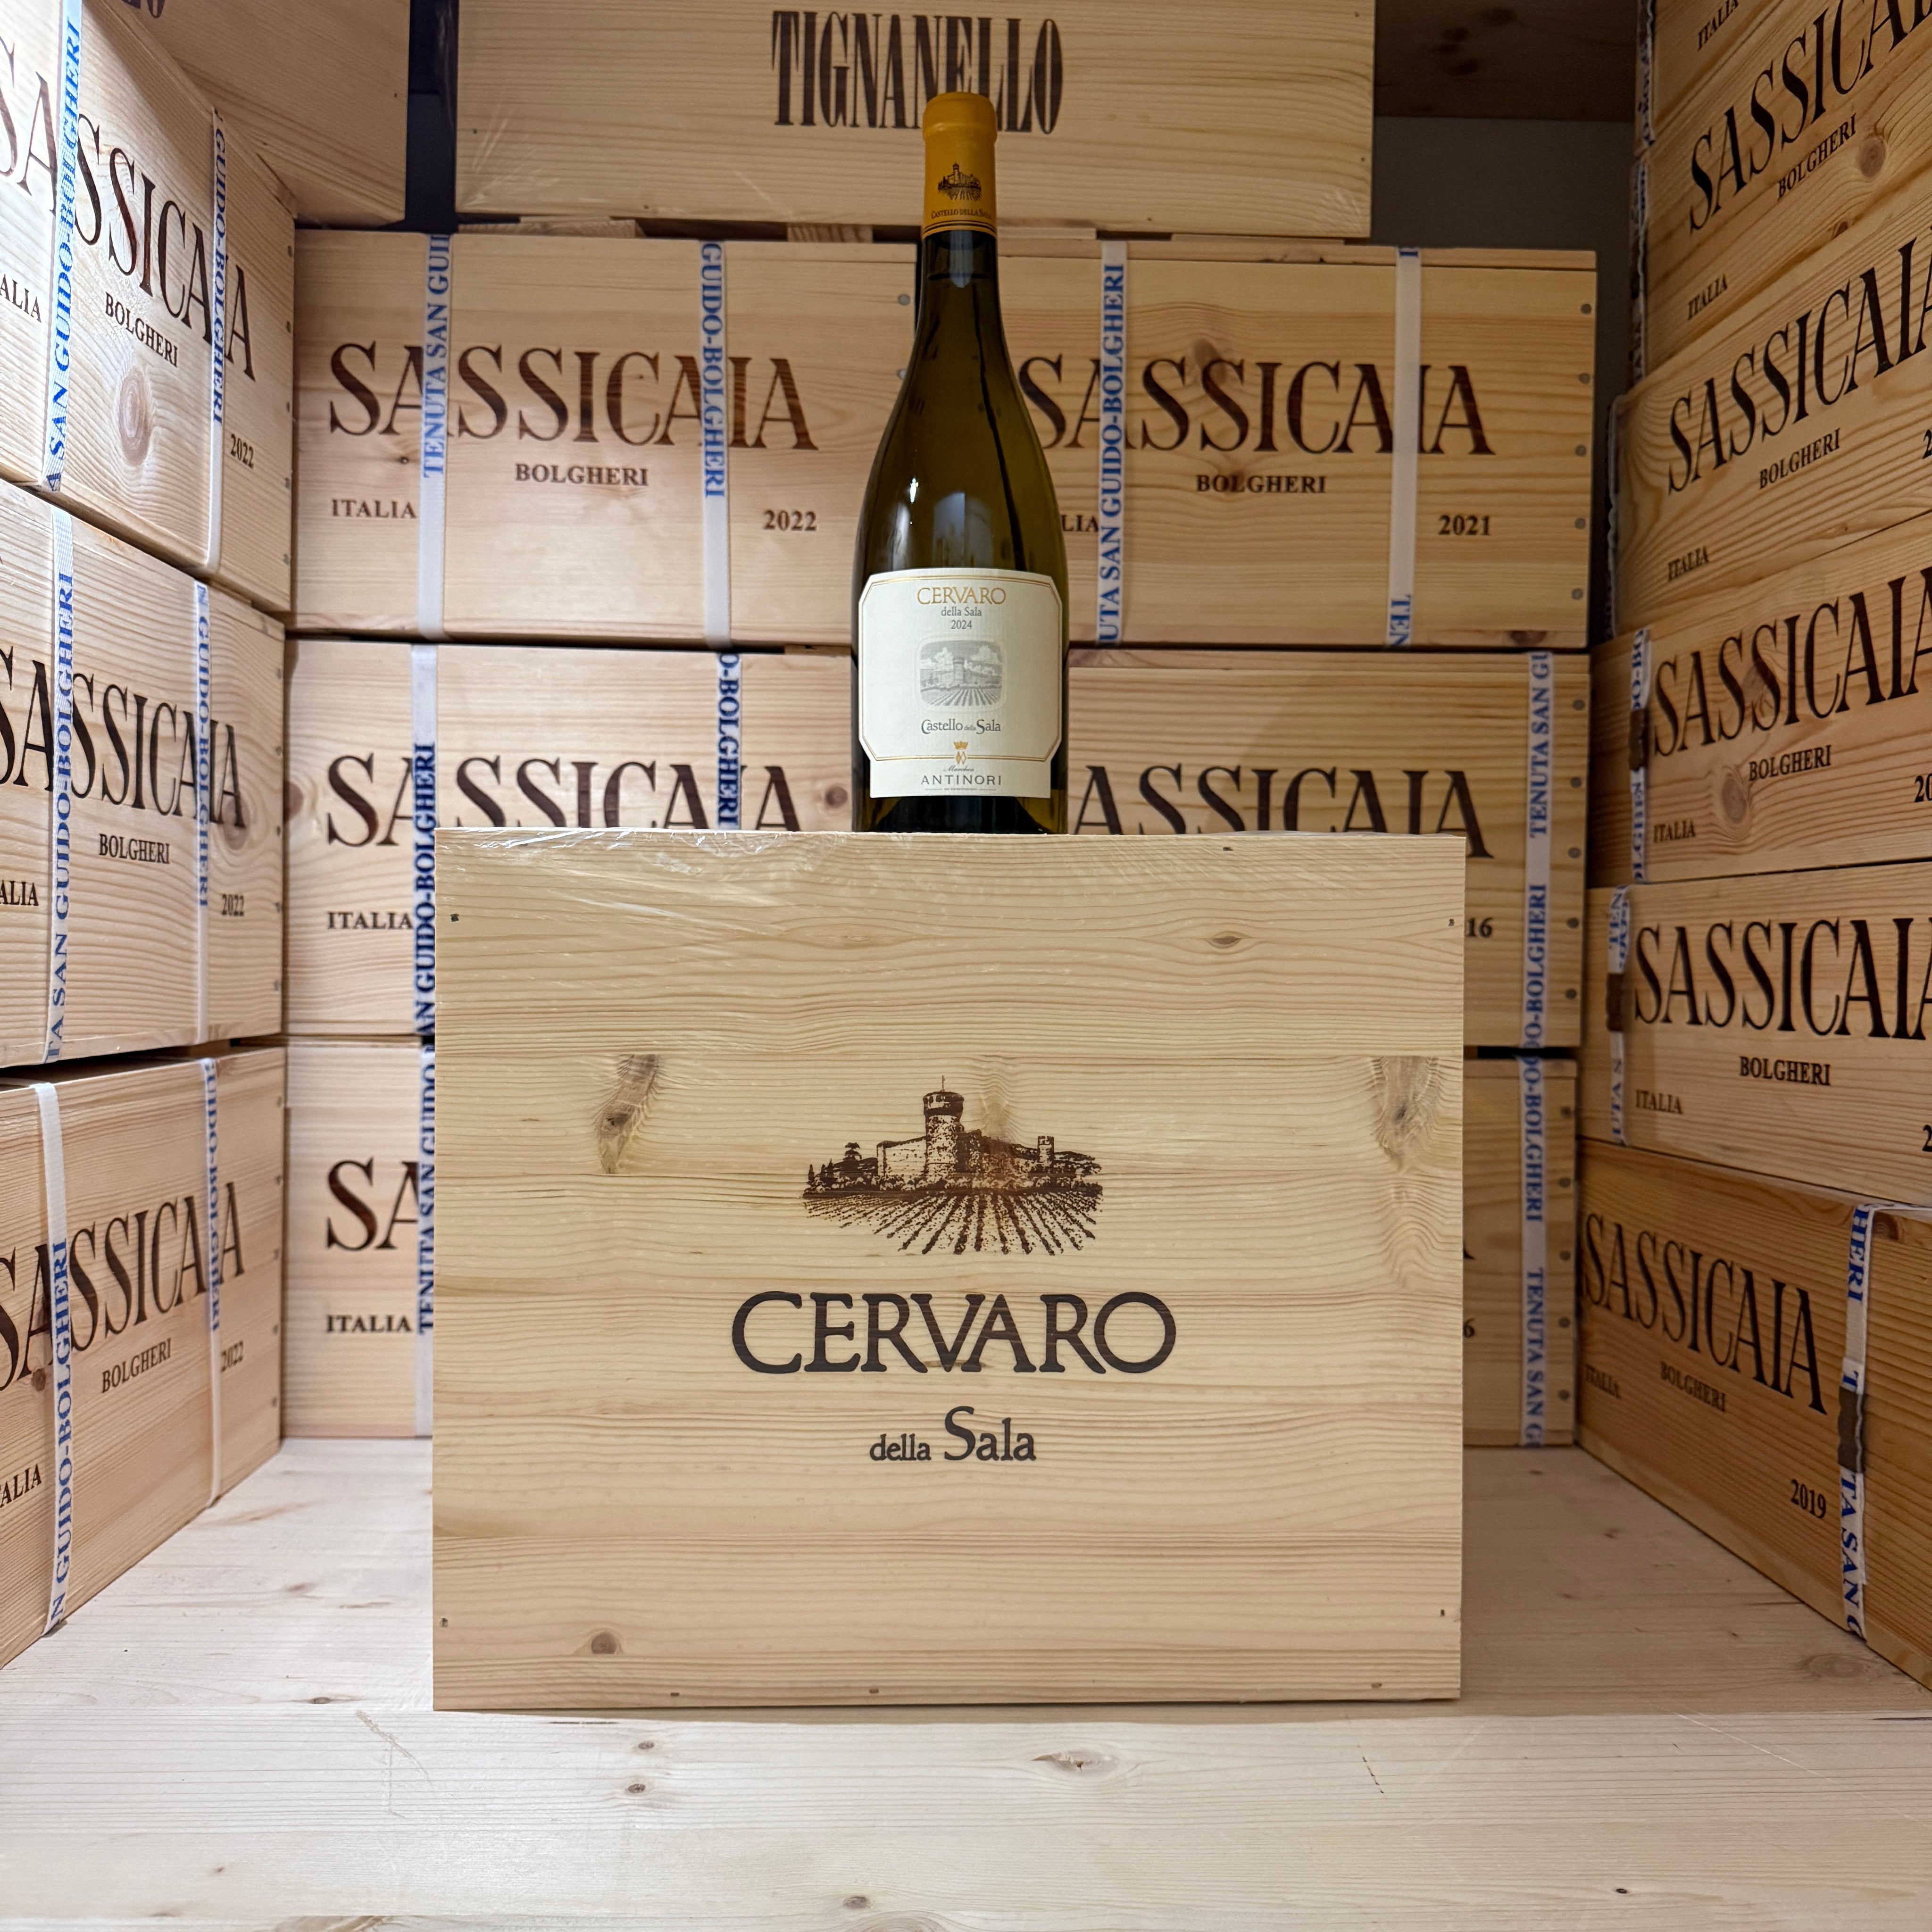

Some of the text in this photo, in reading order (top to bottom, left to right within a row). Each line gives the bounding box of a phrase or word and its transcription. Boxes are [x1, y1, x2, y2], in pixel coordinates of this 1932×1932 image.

[1698, 0, 1739, 51] ITALIA
[772, 11, 1063, 134] TIGNANELLO
[1689, 0, 1932, 233] SASSICA
[1777, 113, 1857, 200] BOLGHERI
[1687, 273, 1728, 321] ITALIA
[105, 291, 179, 368] BOLGHERI
[426, 303, 449, 360] SAN
[701, 242, 726, 499] GUIDO-BOLGHERI
[1100, 264, 1125, 518] GUIDO-BOLGHERI
[49, 381, 68, 460] SAN
[423, 366, 447, 478] TENUTA
[231, 433, 254, 468] 2022
[515, 463, 649, 486] BOLGHERI
[1759, 428, 1840, 490] BOLGHERI
[332, 499, 417, 519] ITALIA
[1196, 475, 1326, 494] BOLGHERI
[763, 510, 817, 532] 2022
[1438, 515, 1491, 536] 2021
[1100, 526, 1122, 581] SAN
[1667, 546, 1709, 582] ITALIA
[917, 587, 1007, 605] CERVARO
[941, 607, 982, 617] della Sala
[951, 620, 973, 630] 2024
[921, 718, 963, 735] Castello
[976, 719, 1001, 735] Sala
[1531, 686, 1549, 735] SAN
[56, 572, 73, 920] GUIDO-BOLGHERI
[1748, 744, 1832, 781] BOLGHERI
[921, 775, 1001, 785] ANTINORI
[1529, 741, 1549, 839] TENUTA
[99, 833, 170, 865] BOLGHERI
[1653, 820, 1696, 843] ITALIA
[413, 742, 435, 993] GUIDO-BOLGHERI
[221, 893, 245, 917] 2022
[328, 911, 413, 930] ITALIA
[52, 932, 67, 1007] SAN
[1739, 1056, 1832, 1086] BOLGHERI
[1635, 1089, 1683, 1115] ITALIA
[327, 1315, 413, 1333] ITALIA
[732, 1291, 1176, 1374] CERVARO
[1526, 1267, 1544, 1369] TENUTA
[1583, 1212, 1827, 1415] SASSICAIA
[101, 1338, 172, 1394] BOLGHERI
[221, 1341, 245, 1372] 2022
[56, 1238, 72, 1584] GUIDO-BOLGHERI
[1526, 1369, 1544, 1415] SAN
[1659, 1360, 1726, 1413] BOLGHERI
[869, 1405, 1036, 1462] della Sala
[1790, 1479, 1827, 1519] 2019
[1841, 1527, 1859, 1609] SAN
